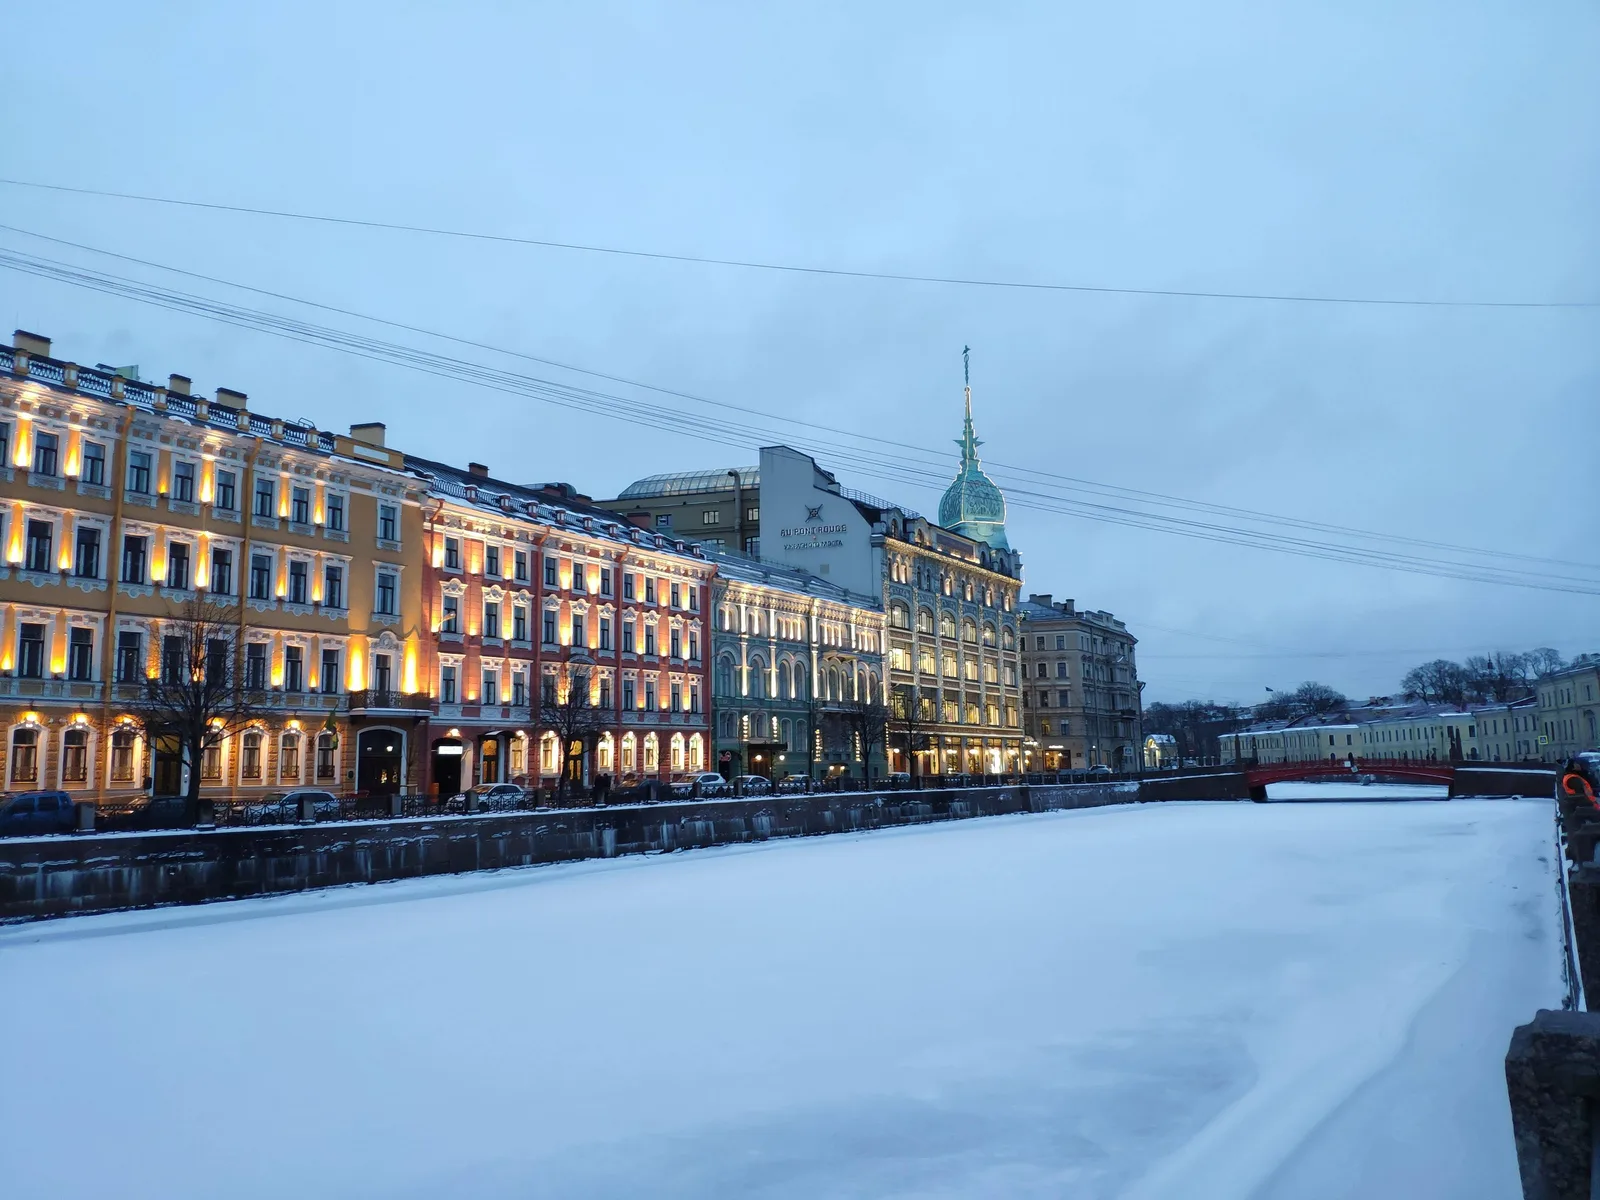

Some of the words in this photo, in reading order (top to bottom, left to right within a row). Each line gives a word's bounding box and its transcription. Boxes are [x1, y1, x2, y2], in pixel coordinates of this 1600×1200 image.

[780, 529, 792, 537] AU
[794, 526, 816, 536] PONT
[818, 524, 847, 534] ROUGE
